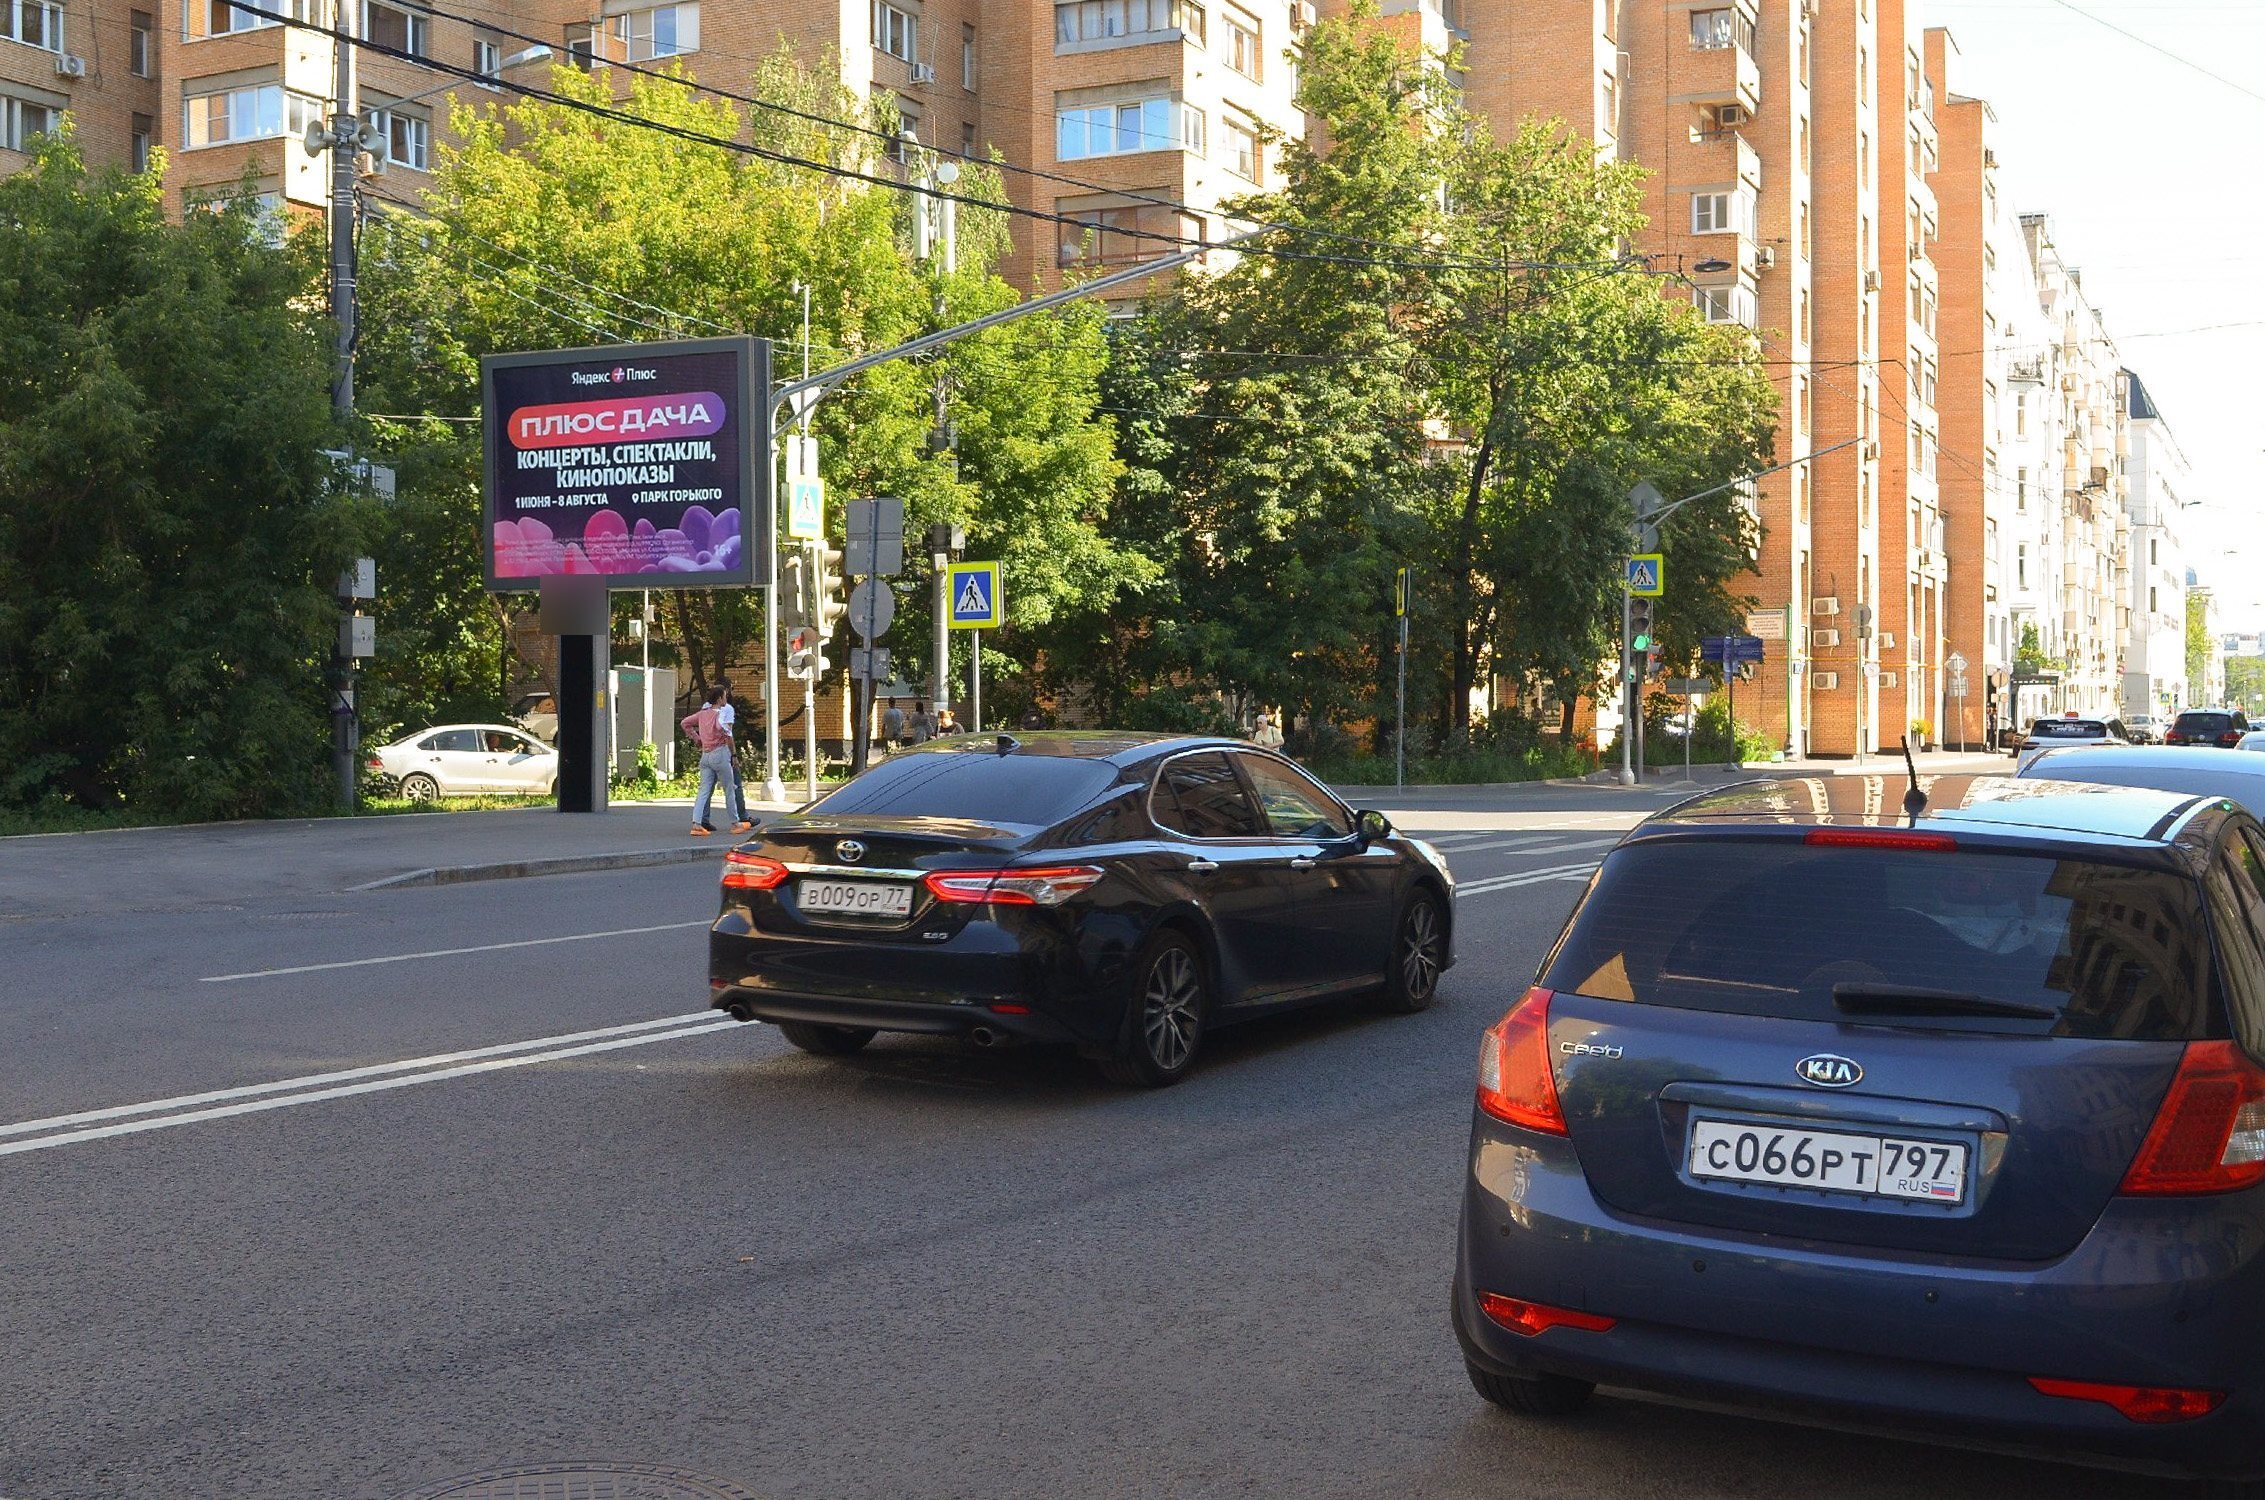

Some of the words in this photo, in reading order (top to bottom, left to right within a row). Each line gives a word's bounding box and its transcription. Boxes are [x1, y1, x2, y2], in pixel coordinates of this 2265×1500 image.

[571, 371, 611, 385] Яндекс
[626, 368, 657, 381] Плюс
[521, 411, 615, 438] ПЛЮС
[620, 403, 711, 433] ДАЧА
[517, 447, 611, 470] КОНЦЕРТЫ,
[613, 441, 717, 464] СПЕКТАКЛИ,
[556, 465, 675, 488] КИНОПОКАЗЫ
[558, 496, 565, 507] 8
[565, 493, 609, 506] АВГУСТА
[640, 490, 669, 503] ПАРК
[669, 488, 722, 502] ГОРЬКОГО
[1806, 1060, 1852, 1080] KIA
[1884, 1143, 1950, 1180] 797
[1898, 1178, 1930, 1195] RUS
